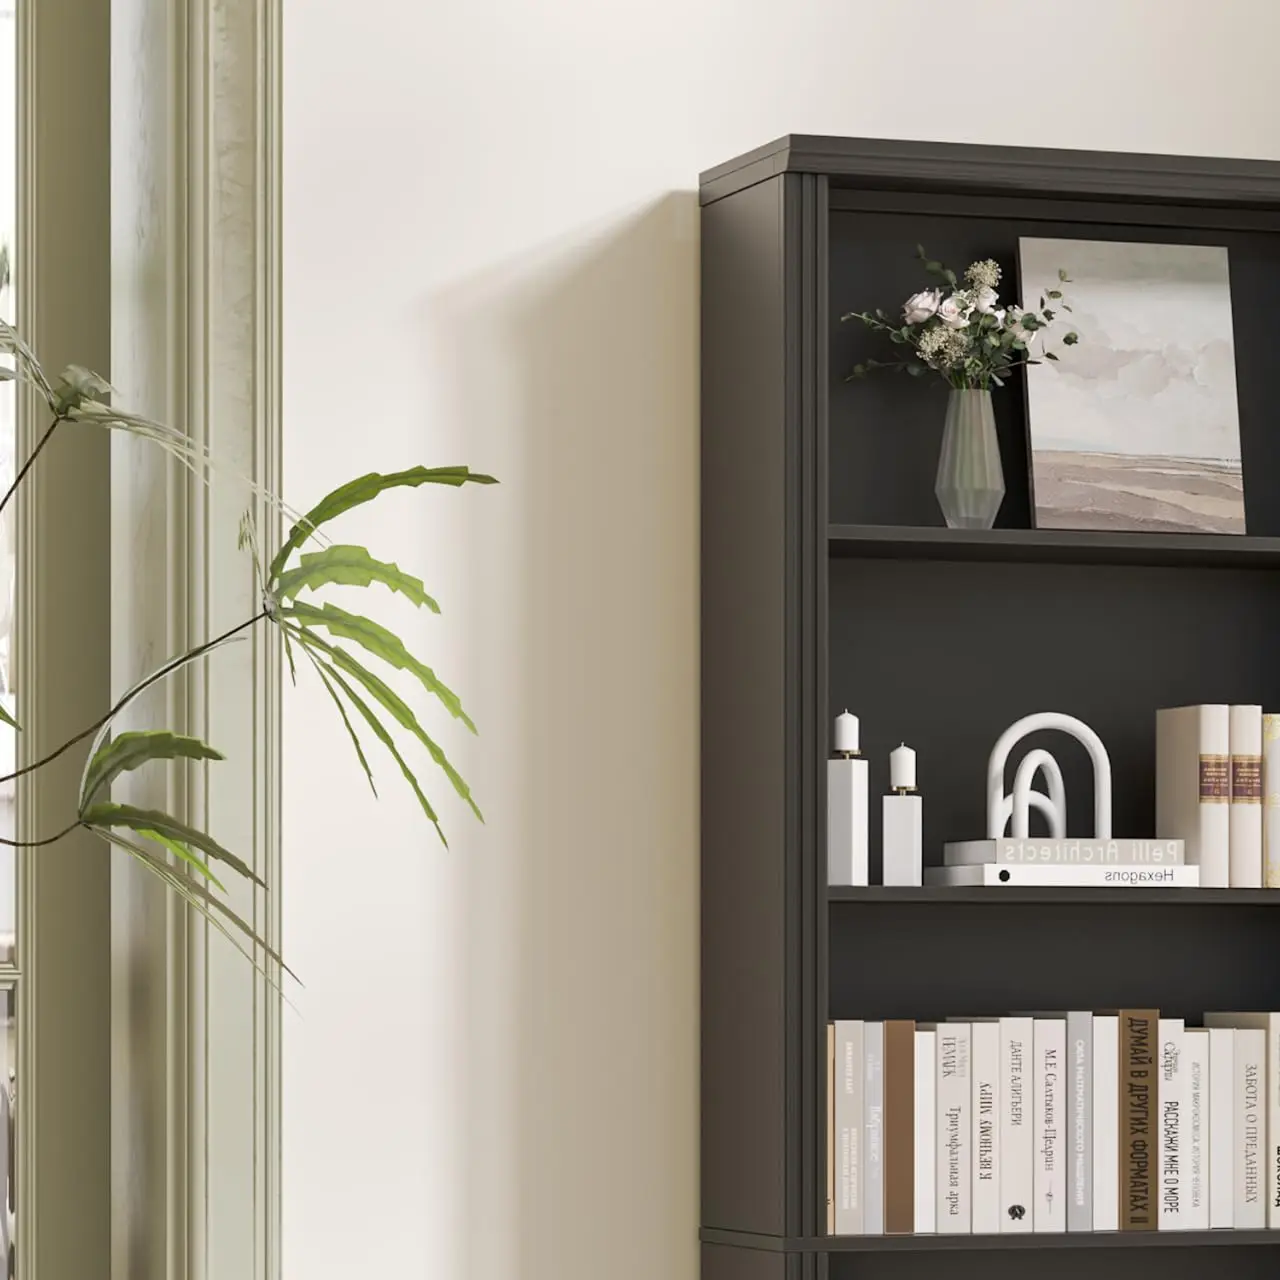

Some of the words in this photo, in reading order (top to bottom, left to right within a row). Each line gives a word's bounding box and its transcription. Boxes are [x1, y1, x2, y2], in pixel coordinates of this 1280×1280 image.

[1010, 1040, 1023, 1073] ДАНТЕ
[1128, 1017, 1152, 1066] ДУМАЙ
[1130, 1069, 1149, 1079] В
[1245, 1063, 1257, 1110] ЗАБОТА
[979, 1082, 993, 1115] МИРУ
[1010, 1074, 1023, 1127] АЛИГЬЕРИ
[1041, 1072, 1058, 1172] Салтыков-Щедрин
[1127, 1083, 1150, 1136] ДРУГИХ
[1245, 1114, 1257, 1122] О
[945, 1105, 962, 1187] Триумфальная
[979, 1119, 993, 1170] ВЕЧНОМУ
[1164, 1101, 1179, 1152] РАССКАЖИ
[979, 1172, 993, 1180] К
[1130, 1139, 1150, 1211] ФОРМАТАХ
[1164, 1155, 1179, 1175] МНЕ
[1244, 1126, 1258, 1203] ПРЕДАННЫХ
[945, 1190, 960, 1216] арка
[1164, 1187, 1179, 1213] МОРЕ
